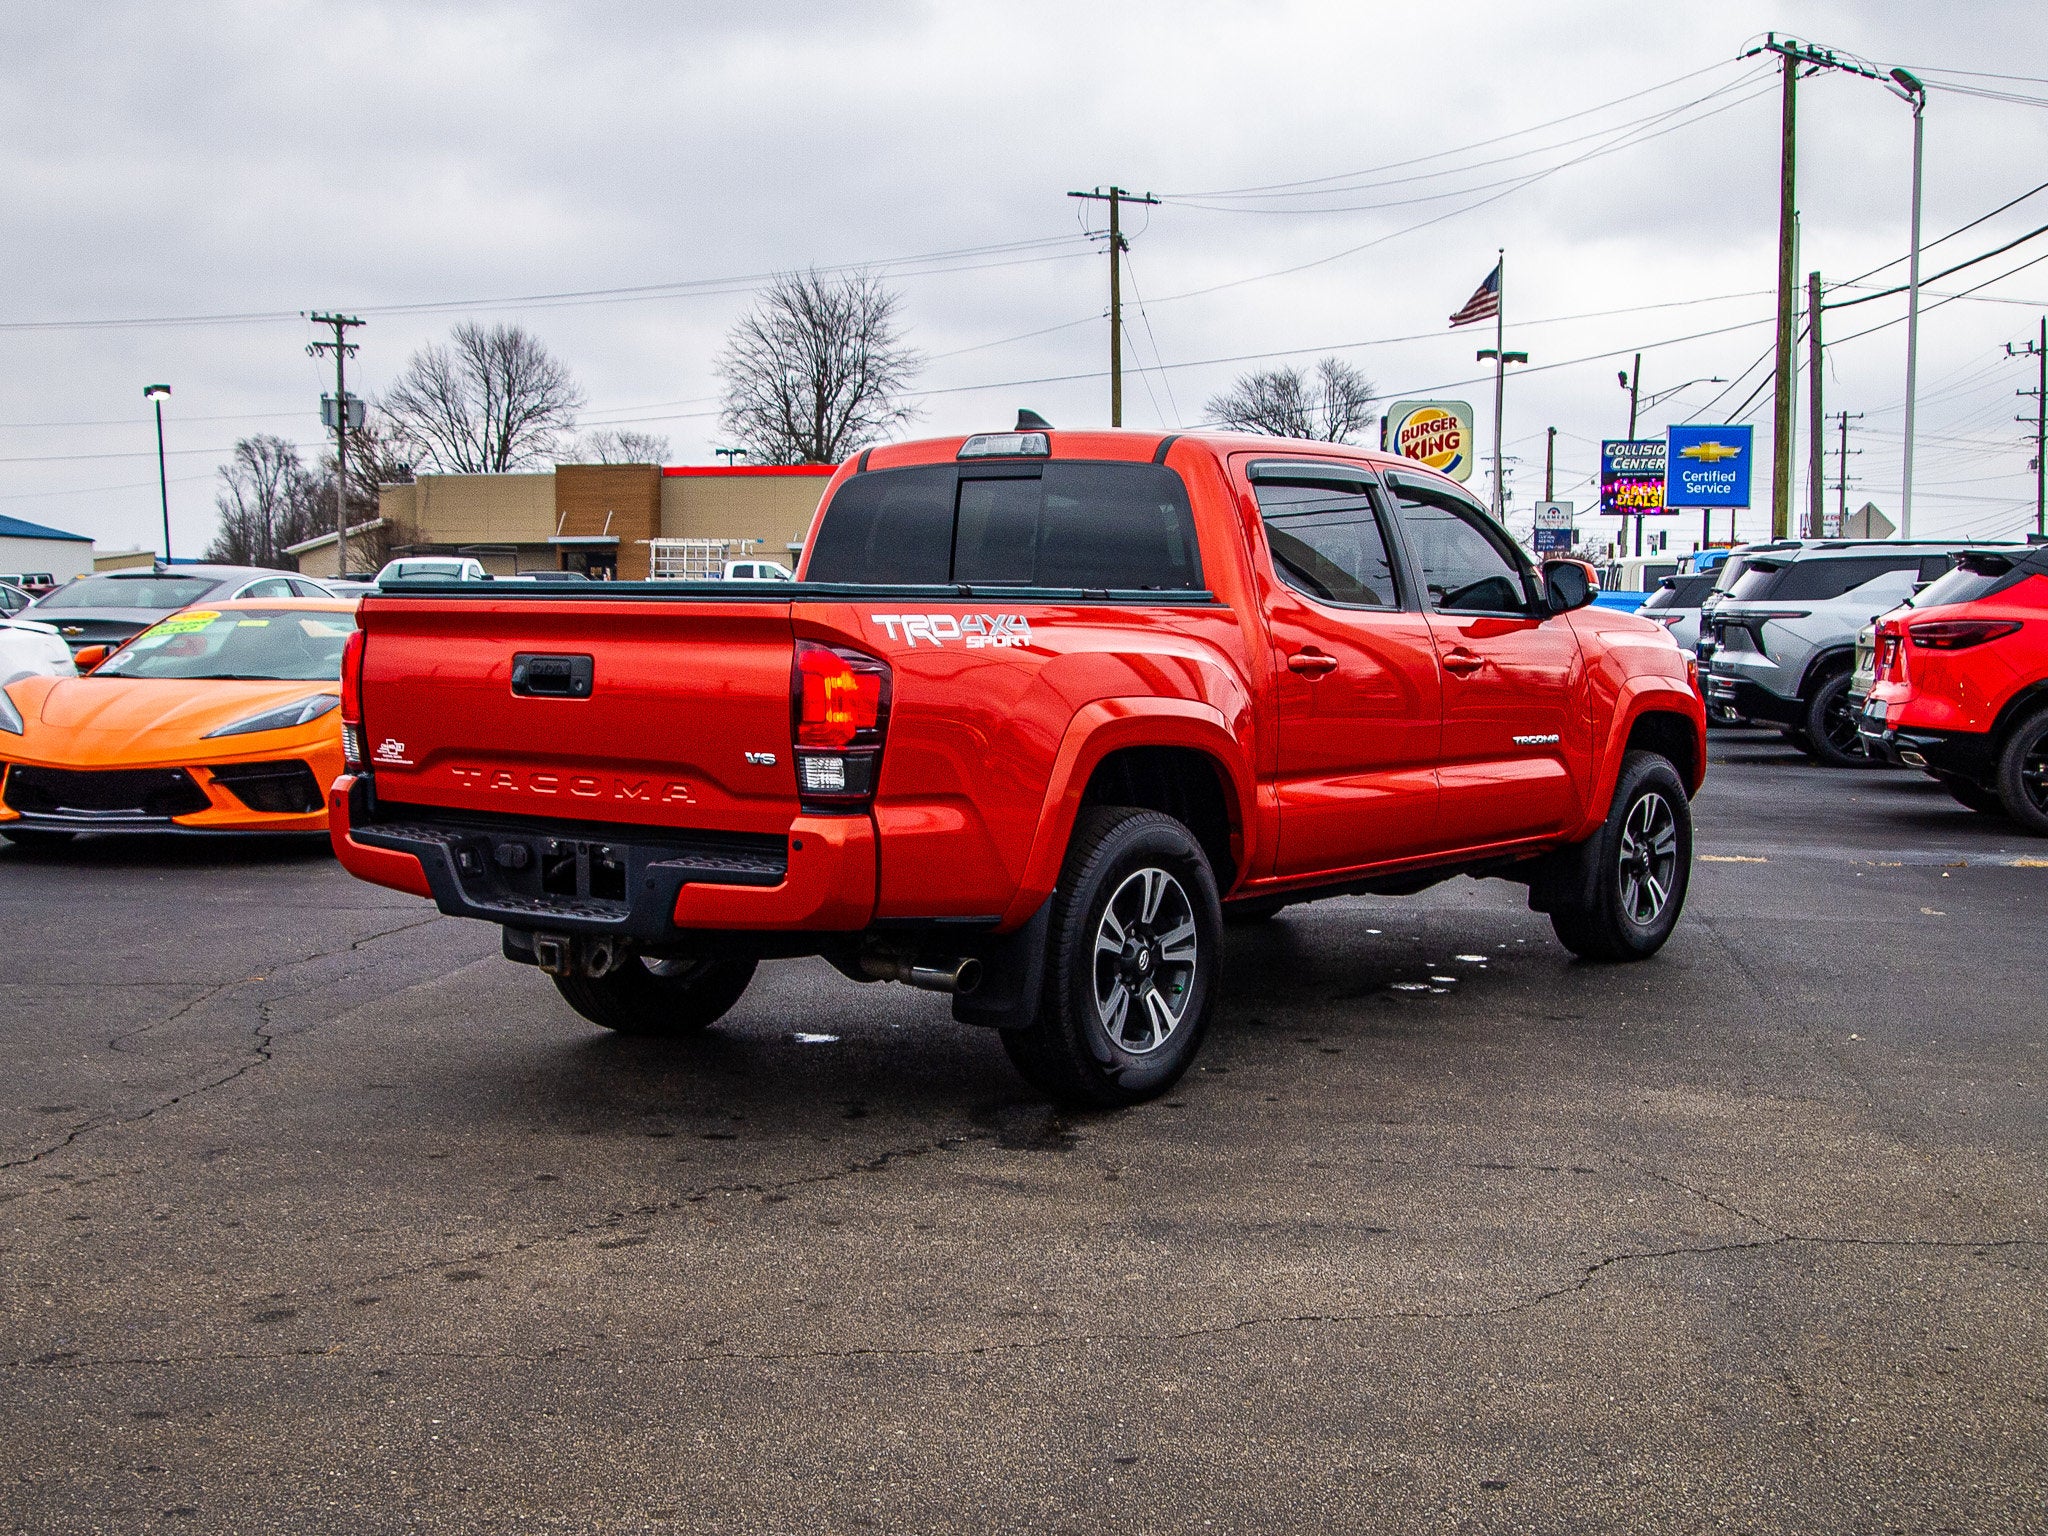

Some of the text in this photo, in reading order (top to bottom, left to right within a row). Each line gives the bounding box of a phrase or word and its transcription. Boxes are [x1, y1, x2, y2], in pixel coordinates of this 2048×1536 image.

[1401, 416, 1457, 444] BURGER
[1405, 431, 1460, 460] KING
[1605, 443, 1667, 456] COLLISIO
[1612, 457, 1666, 470] CENTER
[1682, 470, 1736, 482] Certified
[1686, 482, 1731, 494] Service
[871, 614, 963, 648] TRD
[966, 635, 1032, 649] SPORT
[1512, 734, 1560, 745] TACOMA
[744, 751, 776, 766] V6
[452, 768, 696, 804] TACOMA
